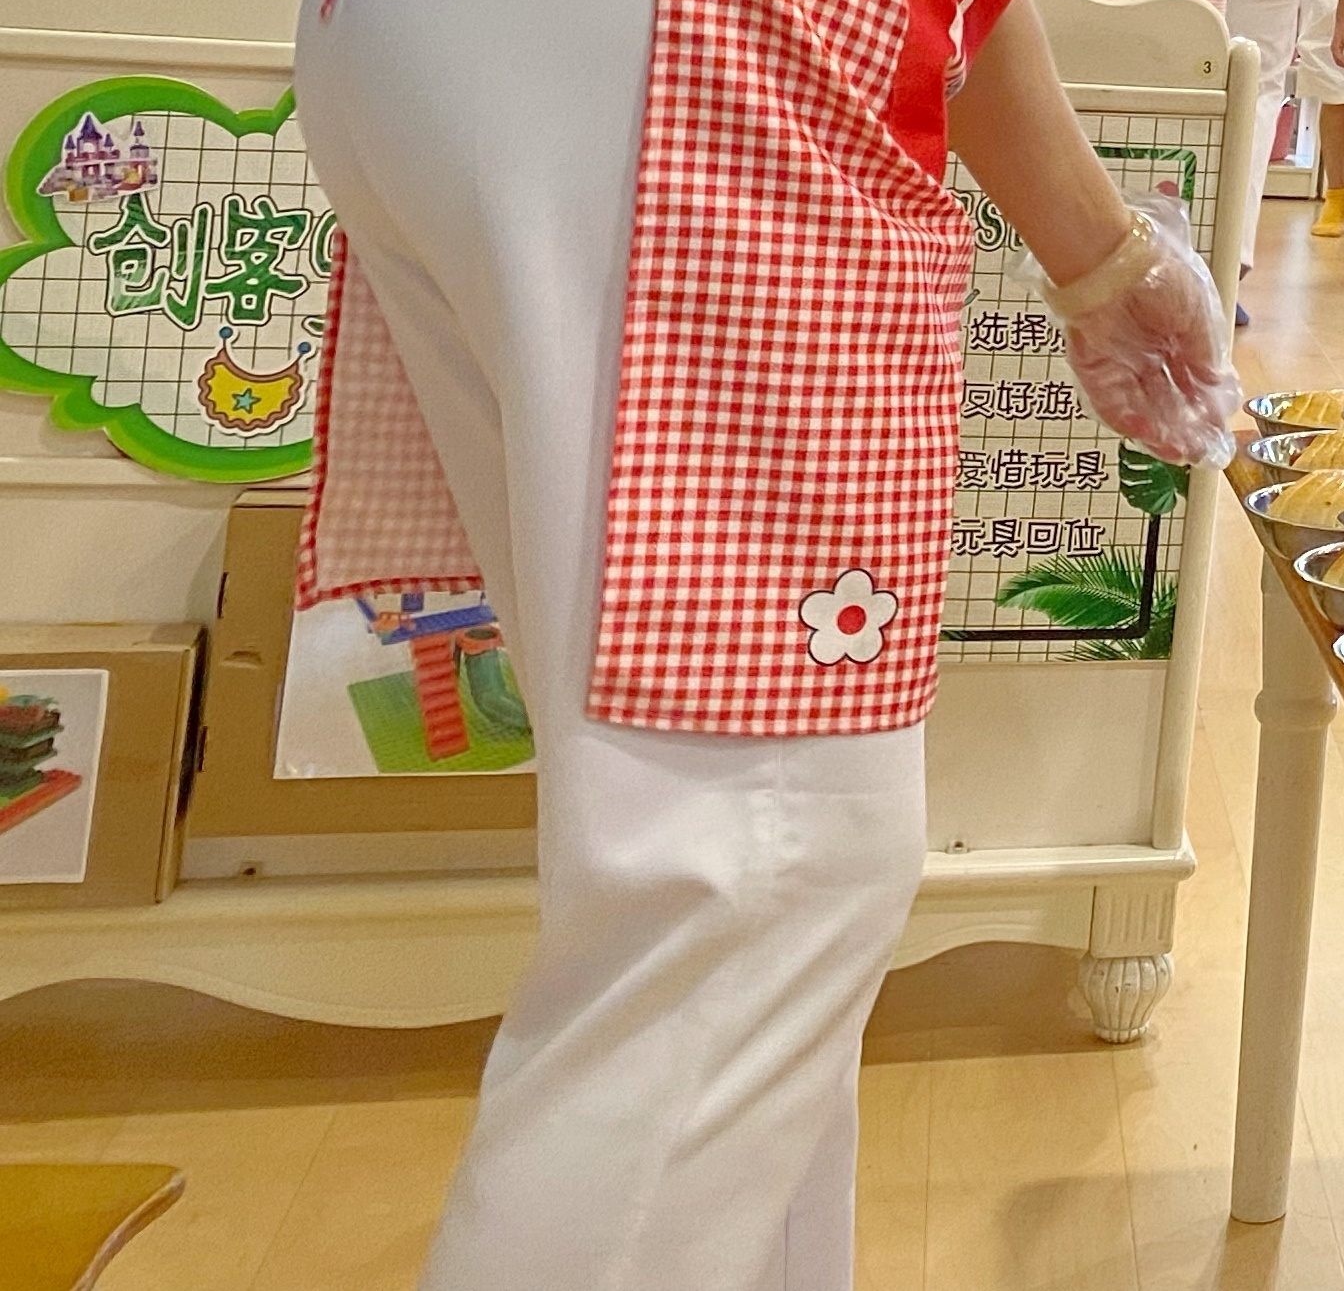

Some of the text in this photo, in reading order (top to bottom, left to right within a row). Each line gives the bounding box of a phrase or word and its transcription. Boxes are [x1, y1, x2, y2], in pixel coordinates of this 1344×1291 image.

[1203, 60, 1211, 74] 3
[960, 380, 1088, 420] 友好游
